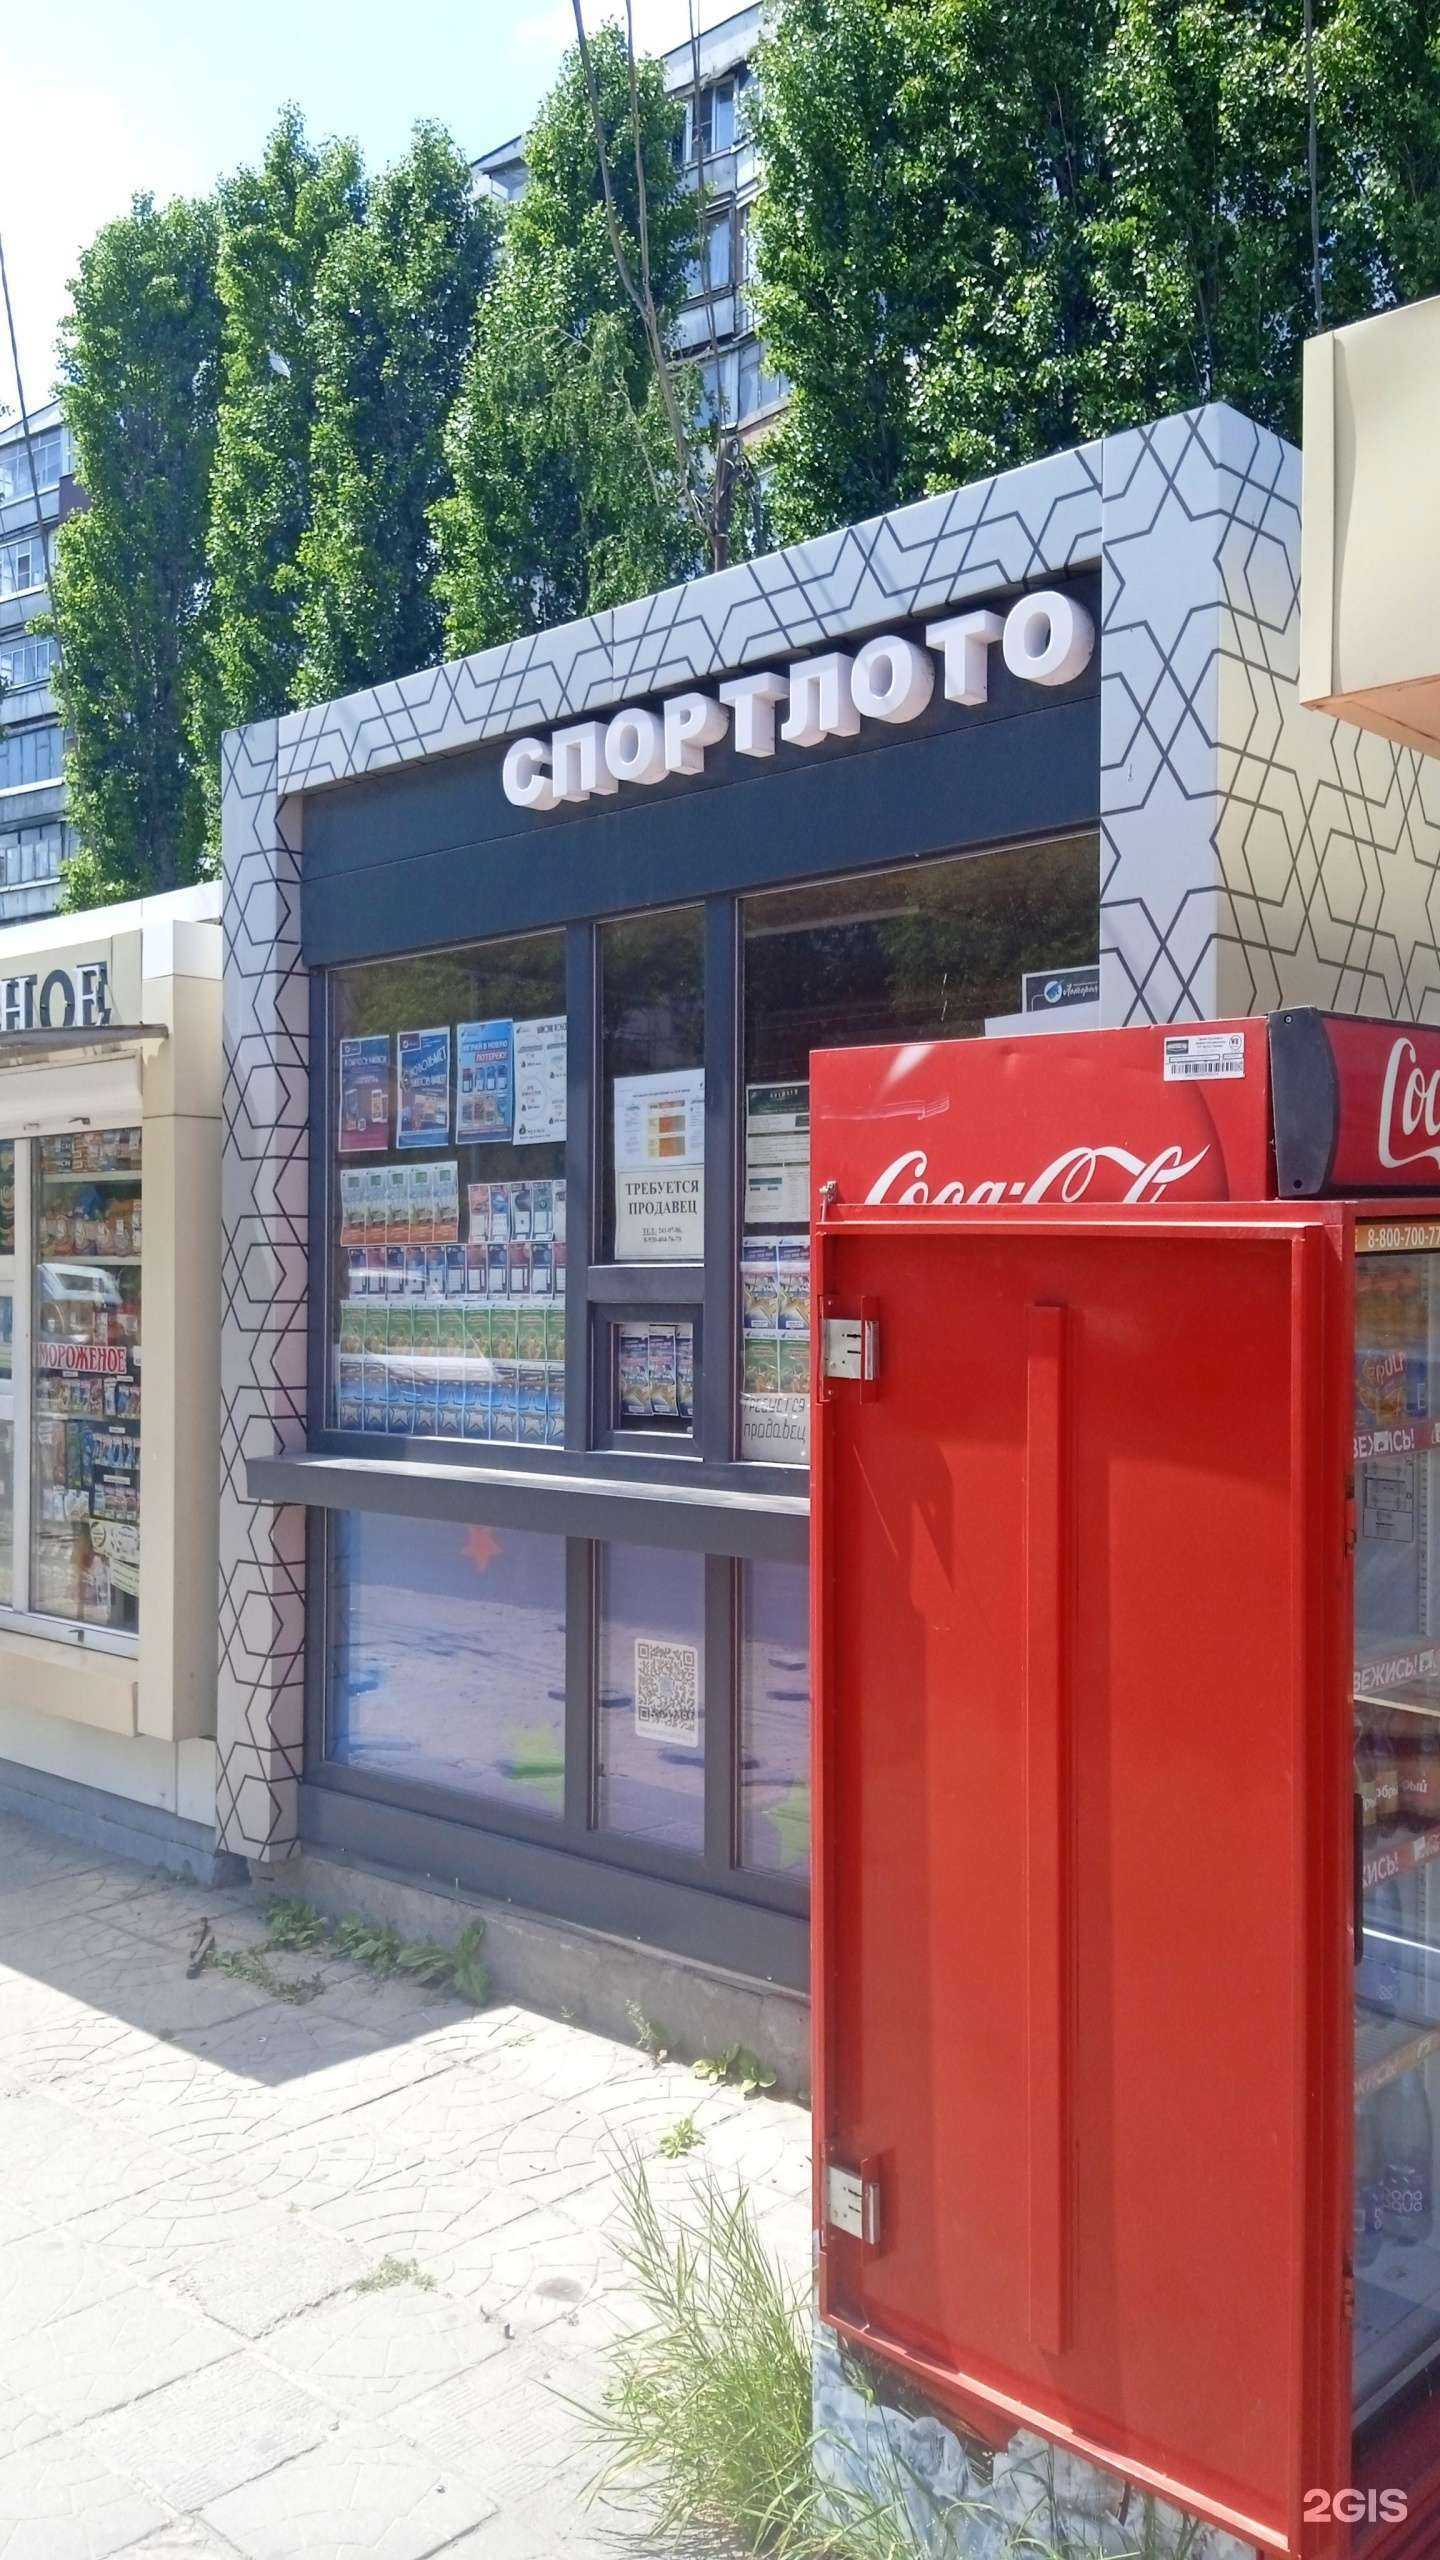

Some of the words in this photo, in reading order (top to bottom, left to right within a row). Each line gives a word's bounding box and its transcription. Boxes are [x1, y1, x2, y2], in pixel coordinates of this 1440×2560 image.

[502, 590, 1095, 811] СПОРТЛОТО
[625, 1180, 699, 1195] ТРЕБУЕТСЯ
[629, 1200, 697, 1215] ПРОДАВЕЦ
[40, 1343, 126, 1373] МОРОЖЕНОЕ
